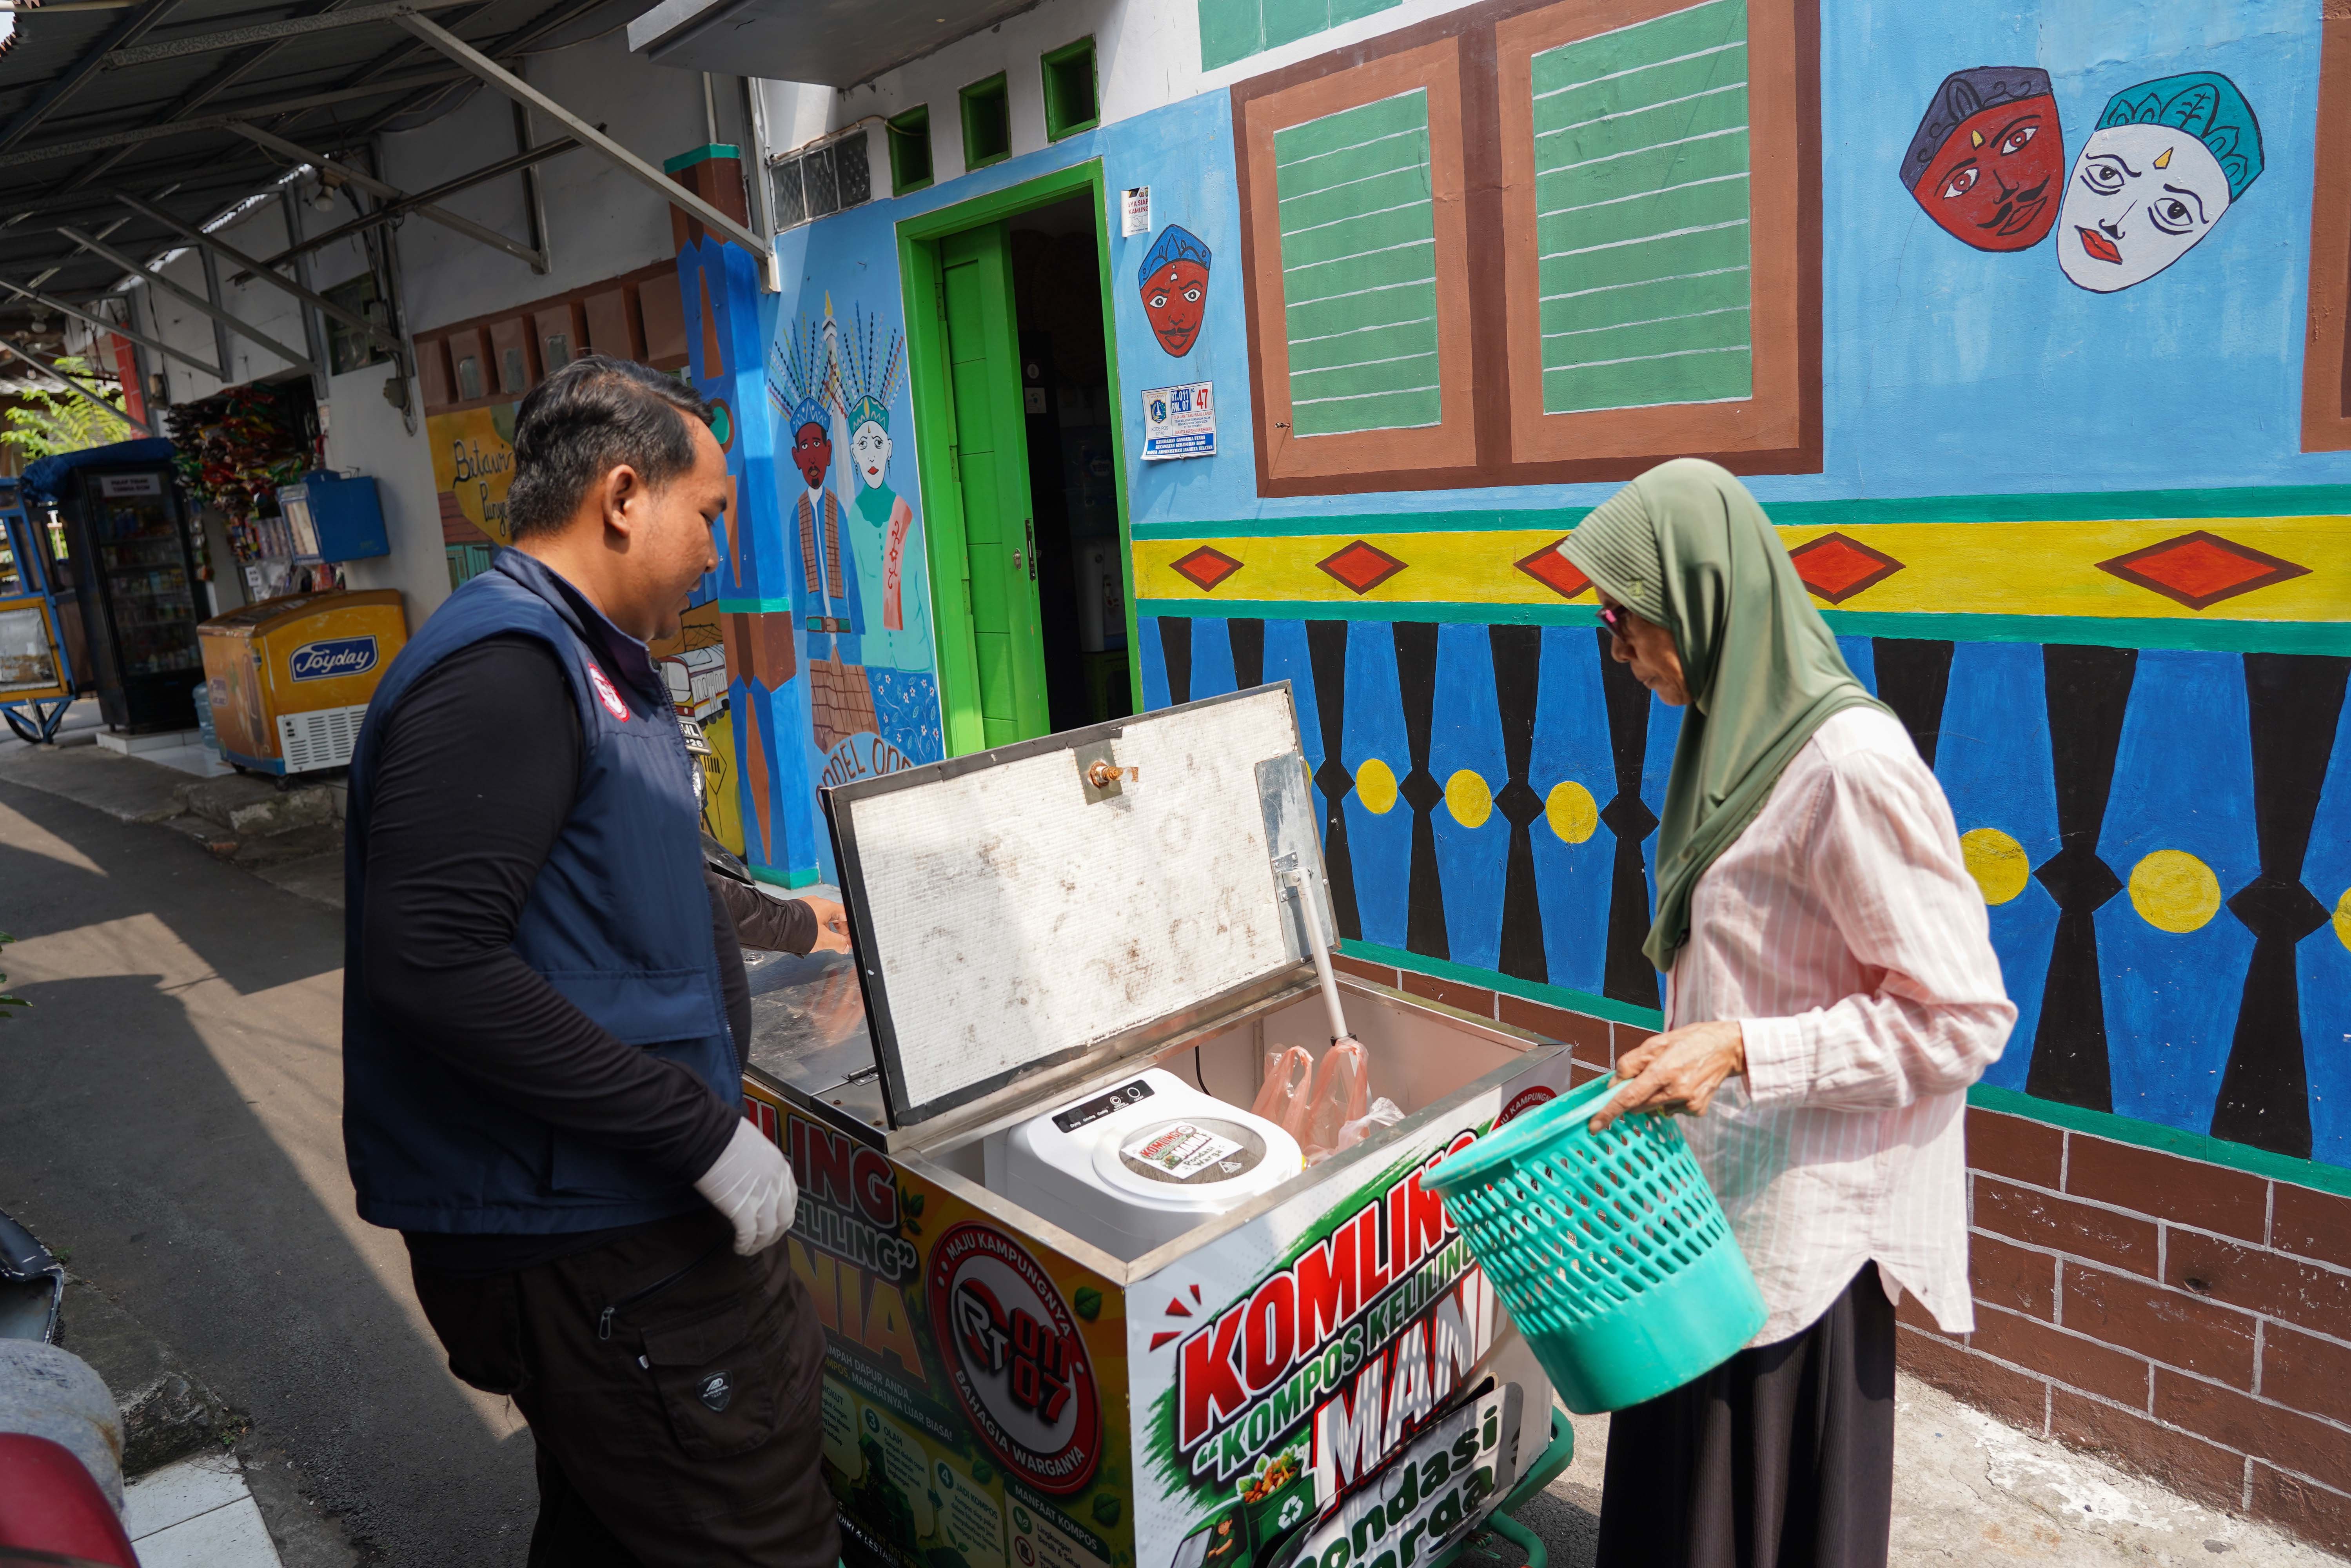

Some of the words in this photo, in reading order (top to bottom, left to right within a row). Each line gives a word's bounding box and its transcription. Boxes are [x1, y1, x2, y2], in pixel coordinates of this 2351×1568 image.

[1129, 206, 1148, 215] KAMLING
[1171, 402, 1181, 412] RW.
[1182, 400, 1189, 410] 07
[1196, 389, 1208, 409] 47
[453, 439, 513, 489] Betawi
[296, 648, 370, 673] Joyday
[1510, 1092, 1552, 1114] KAMPUNGN
[1140, 1131, 1182, 1158] KOMLING
[1183, 1146, 1215, 1165] Pondasi
[1194, 1150, 1223, 1166] Warga
[947, 1237, 976, 1261] MAJU
[977, 1233, 1071, 1337] KAMPUNGNYA
[958, 1289, 1009, 1371] RT
[1012, 1308, 1071, 1382] 011
[855, 1360, 883, 1384] DAPUR
[885, 1379, 913, 1403] ANDA,
[1012, 1354, 1071, 1423] 07
[1313, 1267, 1509, 1508] MANI
[852, 1372, 902, 1411] MANFAATNYA
[904, 1403, 925, 1425] LUAR
[926, 1417, 954, 1442] BIASA!
[869, 1413, 876, 1428] 3
[956, 1370, 1009, 1453] BAHAGIA
[1014, 1445, 1085, 1477] WARGANYA
[884, 1426, 902, 1446] OLAH
[940, 1469, 950, 1485] 4
[956, 1483, 969, 1499] JADI
[971, 1493, 998, 1520] KOMPOS
[1015, 1484, 1056, 1521] MANFAAT
[1058, 1515, 1098, 1550] KOMPOS
[889, 1543, 902, 1560] 011
[1037, 1523, 1072, 1554] Lingkungan
[1038, 1534, 1057, 1553] Bersih
[1058, 1549, 1062, 1557] &
